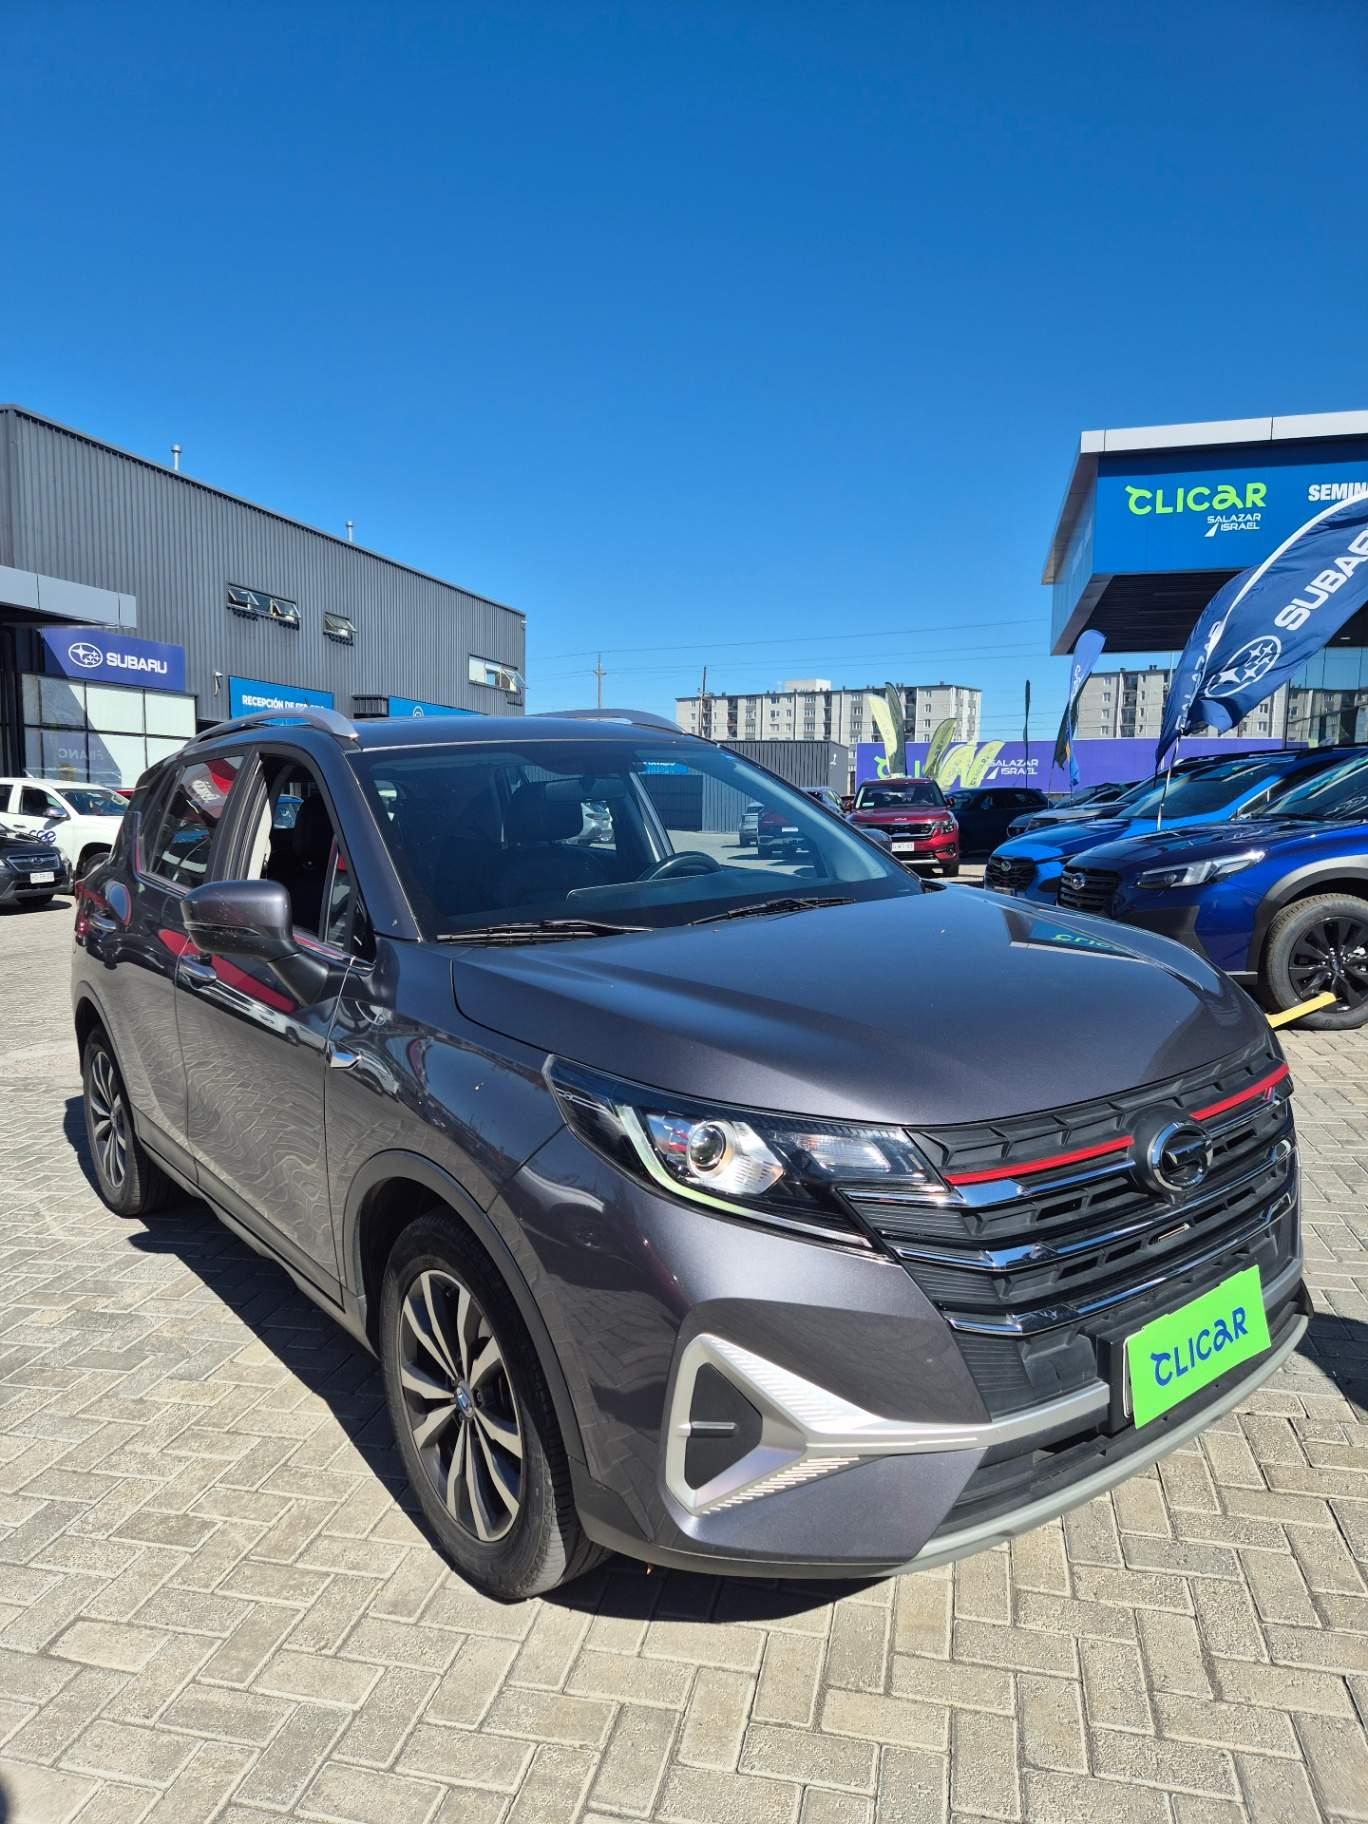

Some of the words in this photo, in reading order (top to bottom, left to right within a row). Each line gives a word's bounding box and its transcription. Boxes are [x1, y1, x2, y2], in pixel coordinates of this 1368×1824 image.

[1207, 513, 1261, 524] SALAZAR
[1220, 522, 1260, 532] ISRAEL
[106, 652, 168, 674] SUBARU
[241, 695, 284, 710] RECEPCIÓN
